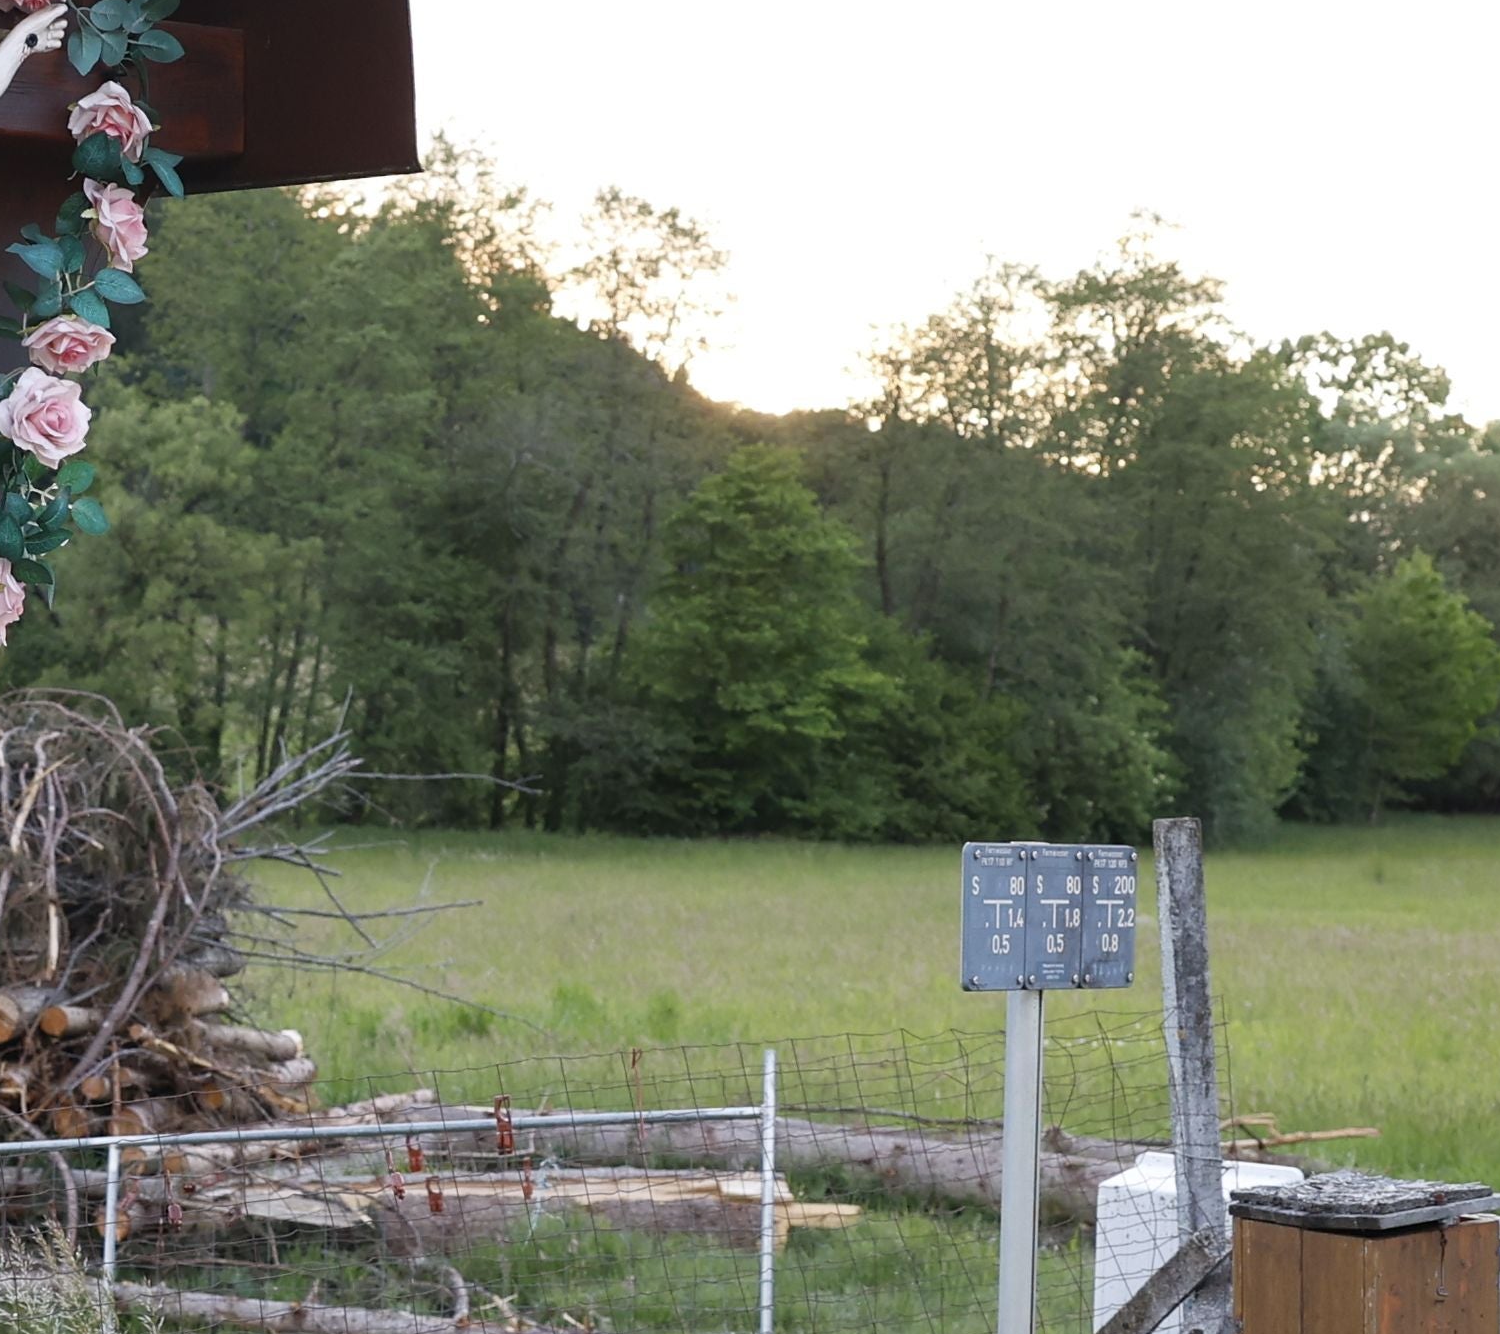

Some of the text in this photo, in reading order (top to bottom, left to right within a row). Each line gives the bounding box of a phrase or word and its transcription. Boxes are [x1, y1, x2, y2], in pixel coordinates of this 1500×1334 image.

[971, 875, 1025, 895] S 80
[1037, 874, 1081, 895] S 80
[1092, 875, 1135, 895] S 200
